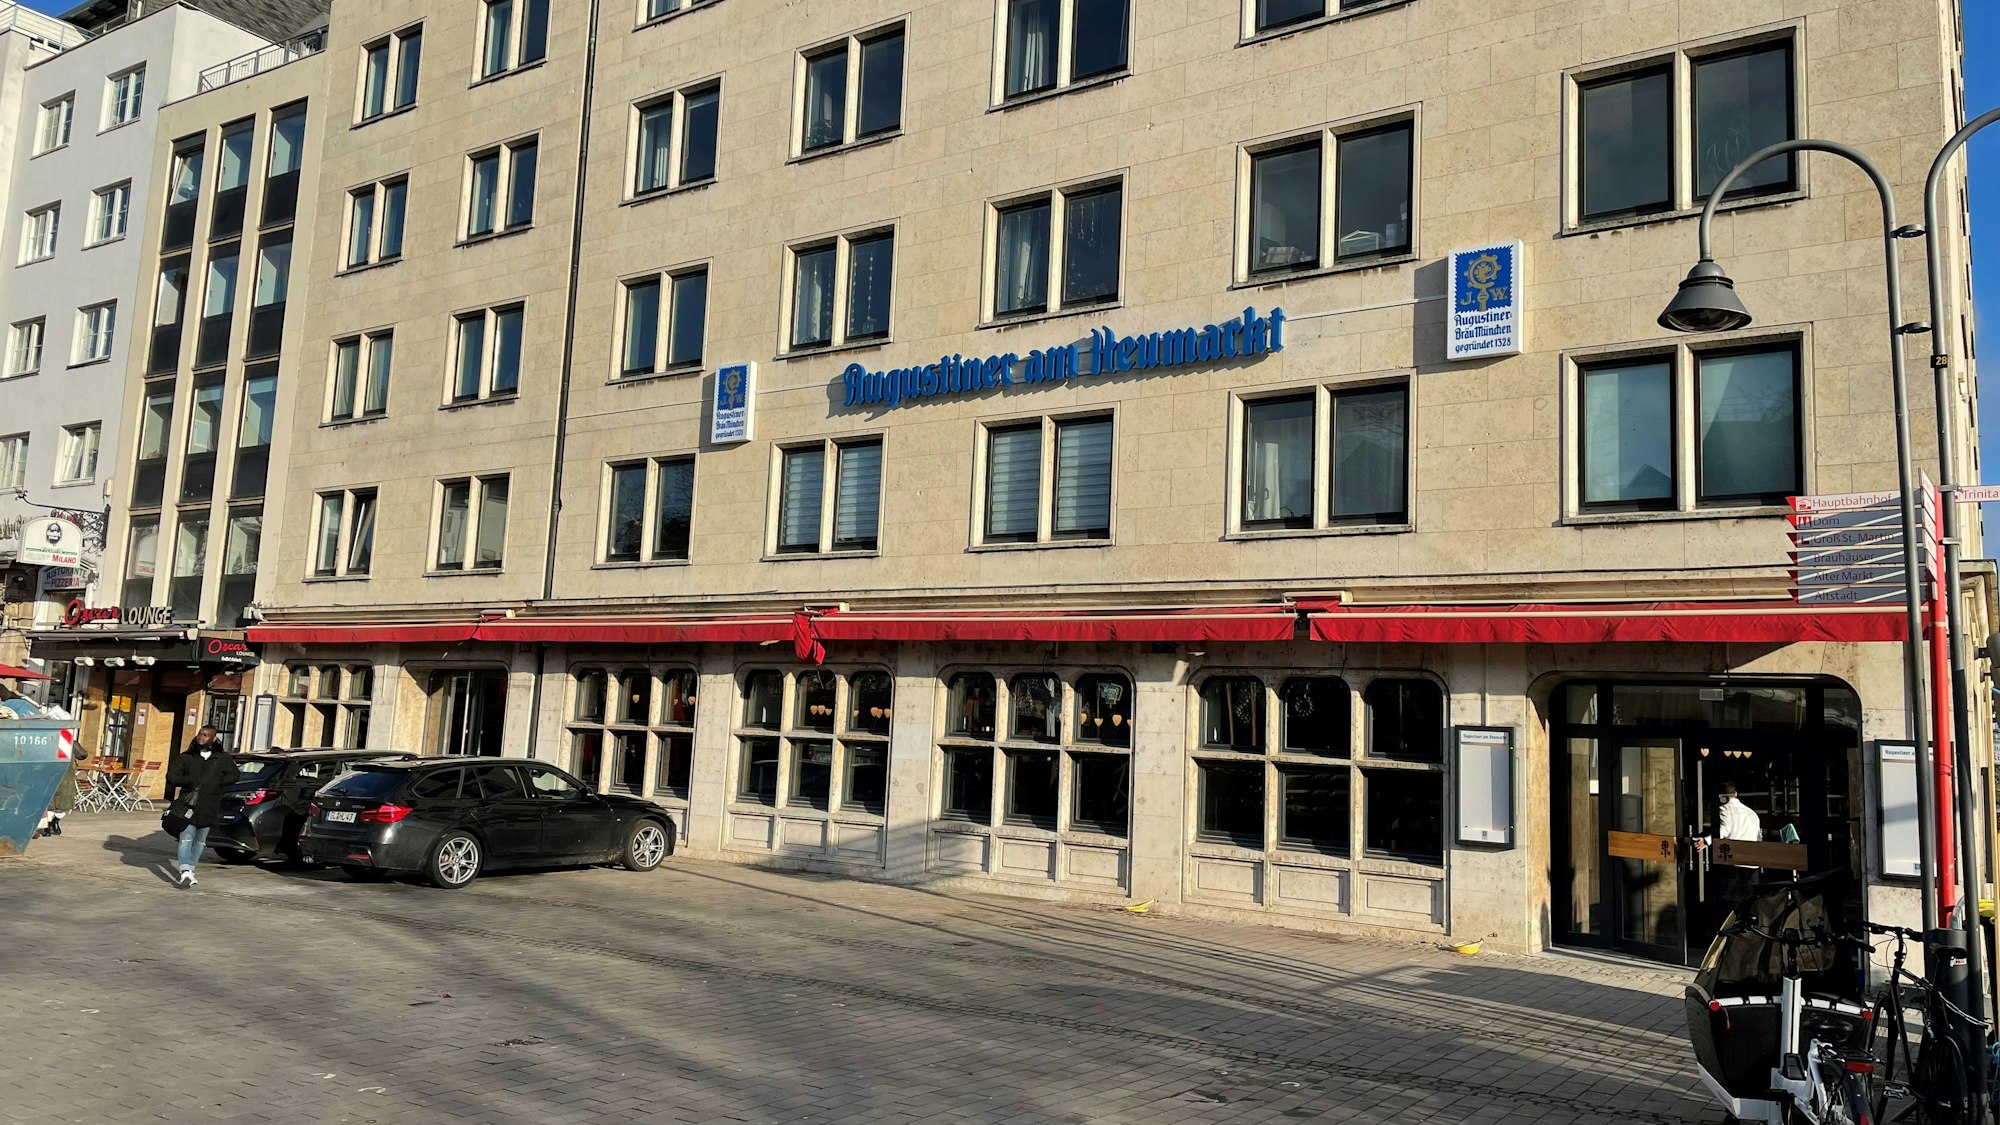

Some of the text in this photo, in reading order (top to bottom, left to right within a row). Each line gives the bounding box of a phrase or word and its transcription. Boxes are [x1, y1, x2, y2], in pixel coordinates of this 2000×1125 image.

[1455, 337, 1512, 354] gegründet 1328
[843, 306, 1287, 408] Augustiner am Heumarkt
[1936, 356, 1948, 366] 28
[1963, 489, 2000, 499] Trinita
[1812, 493, 1892, 508] Hauptbahnhof
[1813, 517, 1840, 526] Dom
[1814, 533, 1840, 543] Groß
[1858, 532, 1894, 542] Martin
[1814, 553, 1874, 563] Brauhäuser
[1814, 570, 1874, 581] Alter Markt
[50, 577, 80, 588] PIZZERIA
[1814, 590, 1858, 601] Altstadt
[120, 606, 173, 625] LOUNGE
[208, 639, 248, 654] Oscar
